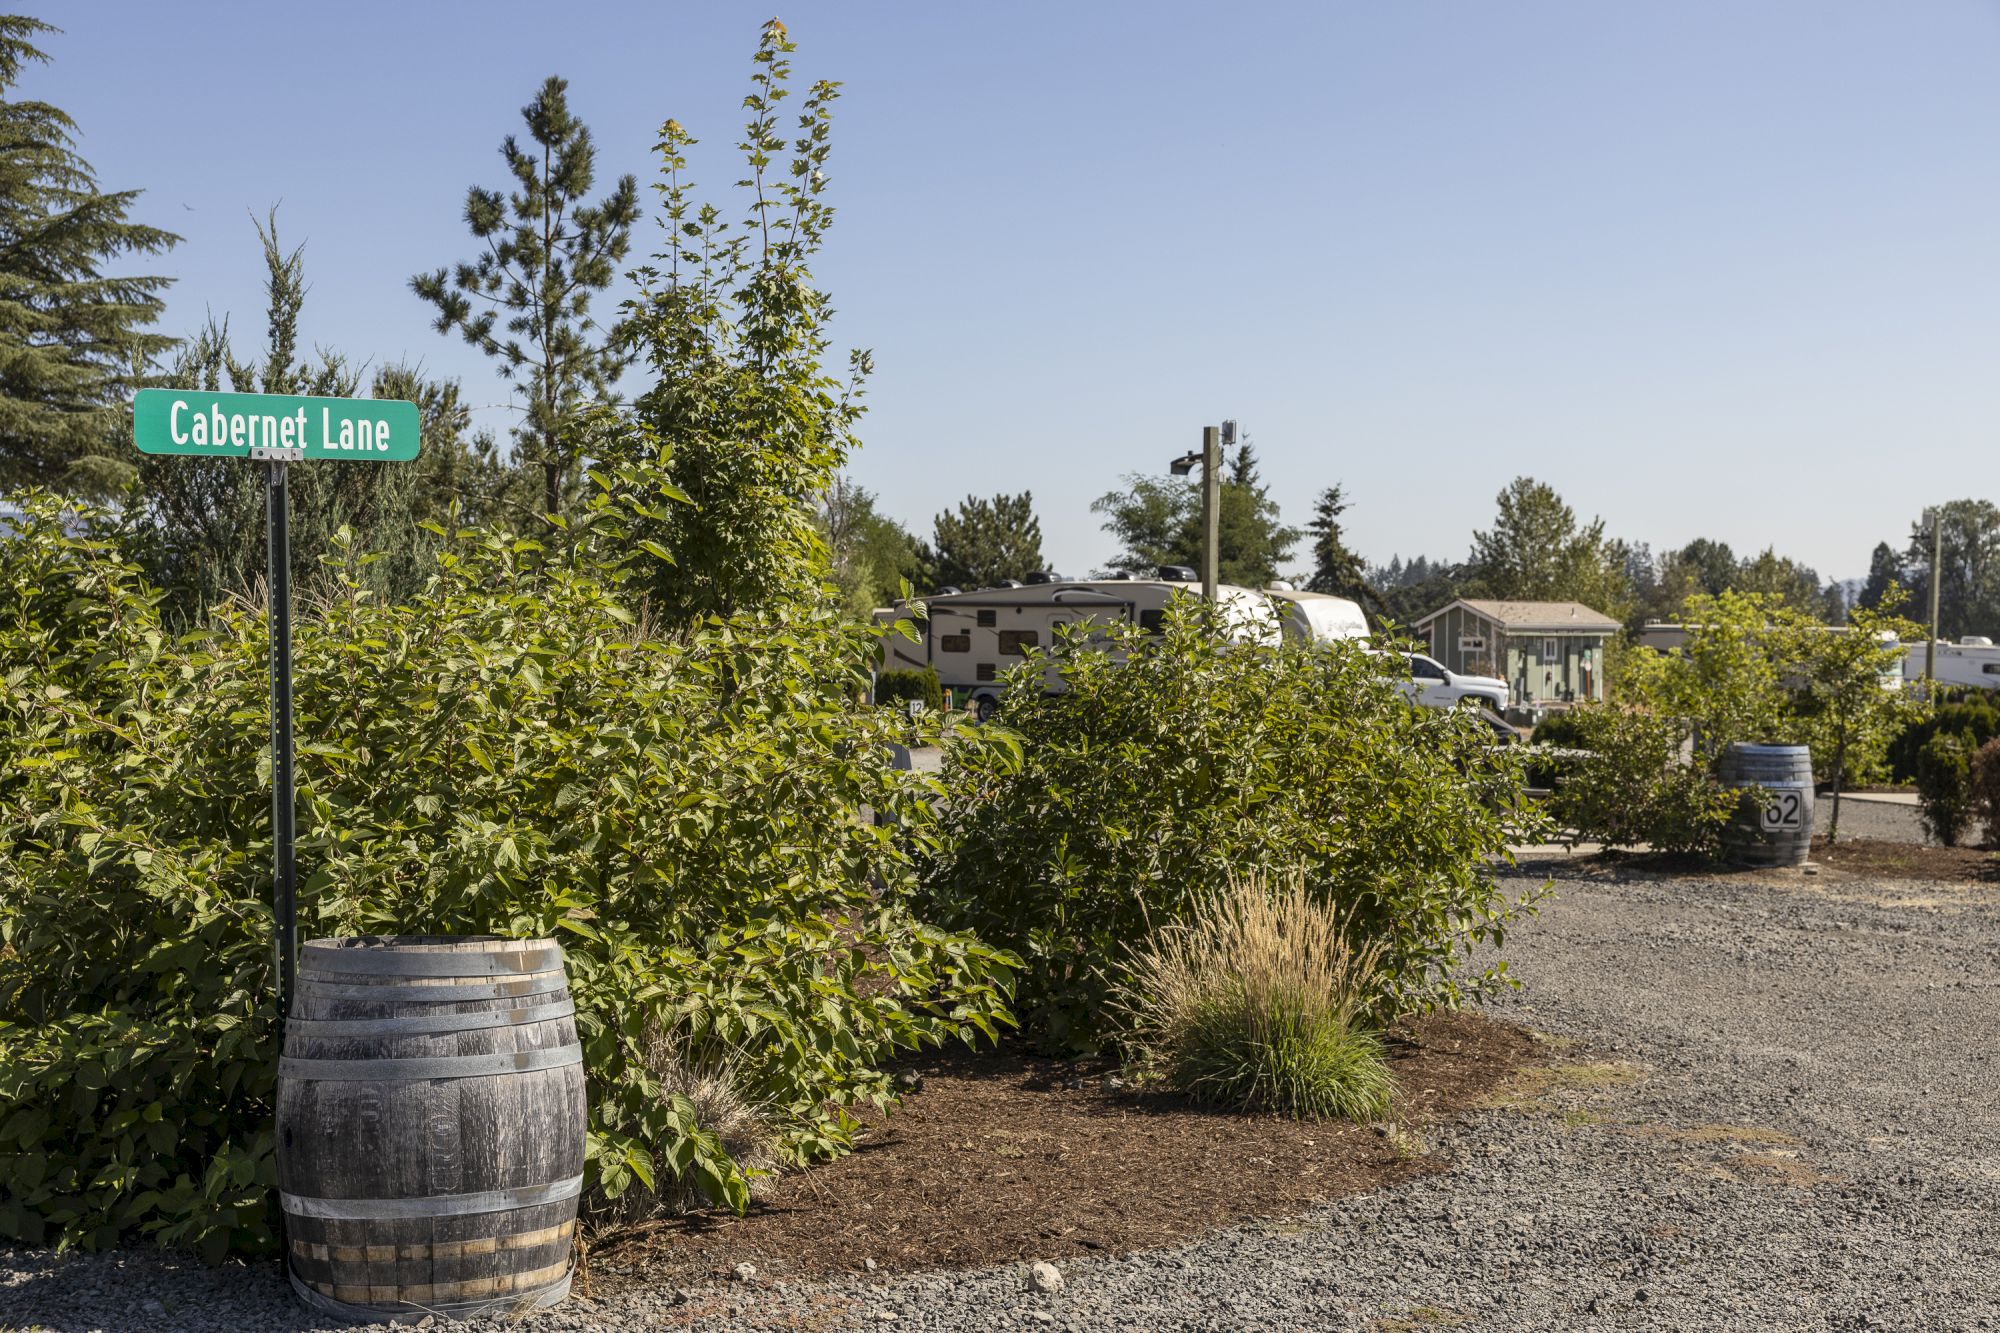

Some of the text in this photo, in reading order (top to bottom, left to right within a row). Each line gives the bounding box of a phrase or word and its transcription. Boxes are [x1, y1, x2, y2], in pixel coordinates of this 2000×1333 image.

[170, 400, 390, 451] Cabernet Lane
[912, 702, 922, 714] 12
[1765, 795, 1799, 824] 62
